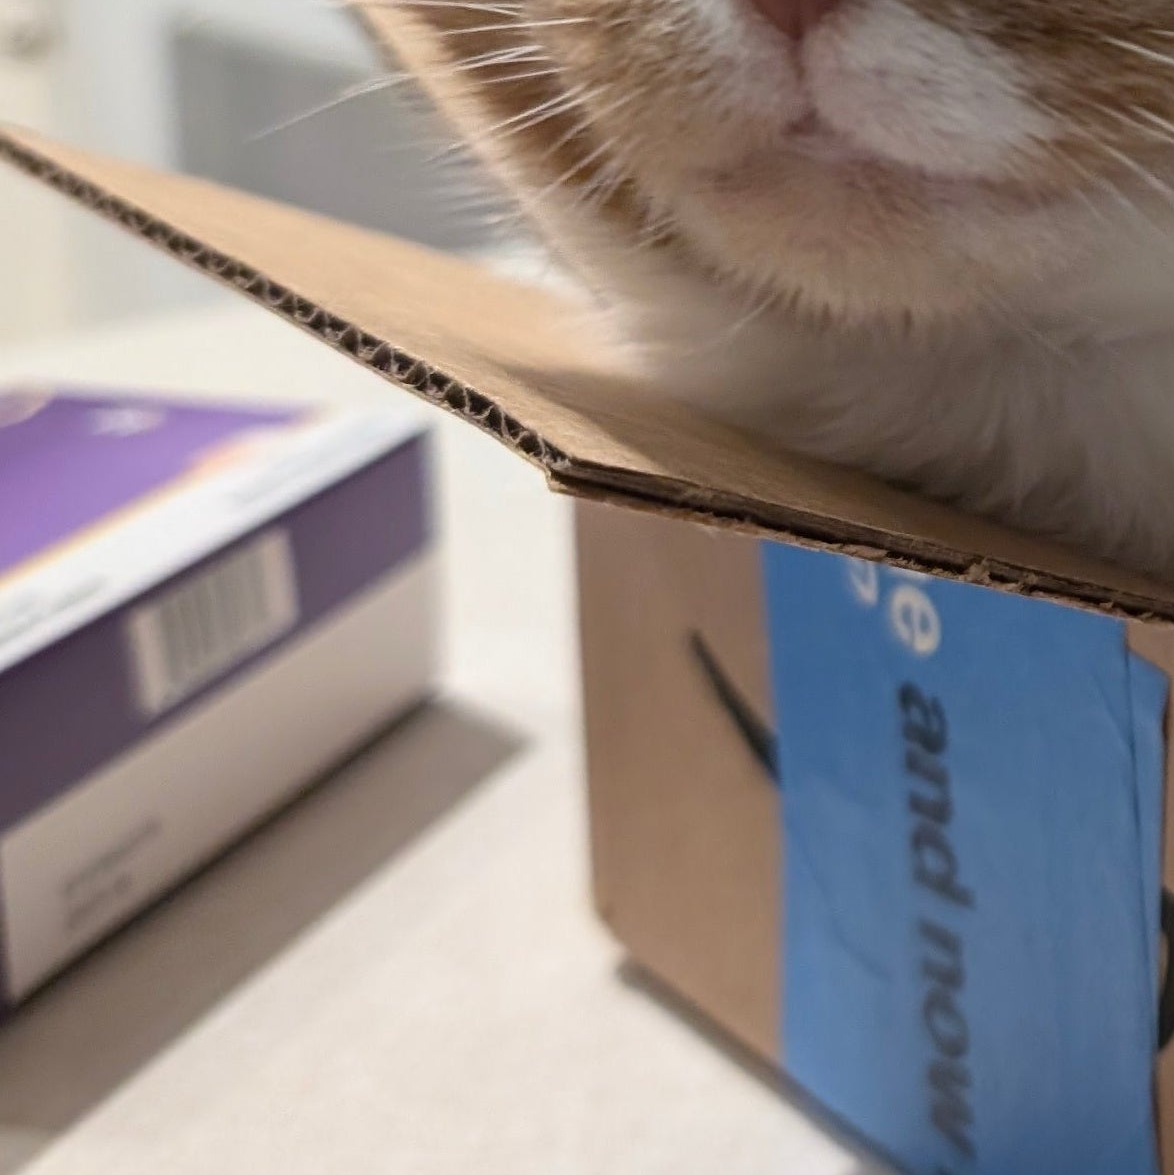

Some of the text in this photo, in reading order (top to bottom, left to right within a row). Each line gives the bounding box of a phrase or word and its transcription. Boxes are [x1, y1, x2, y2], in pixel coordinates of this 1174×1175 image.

[888, 568, 977, 1163] e and now
